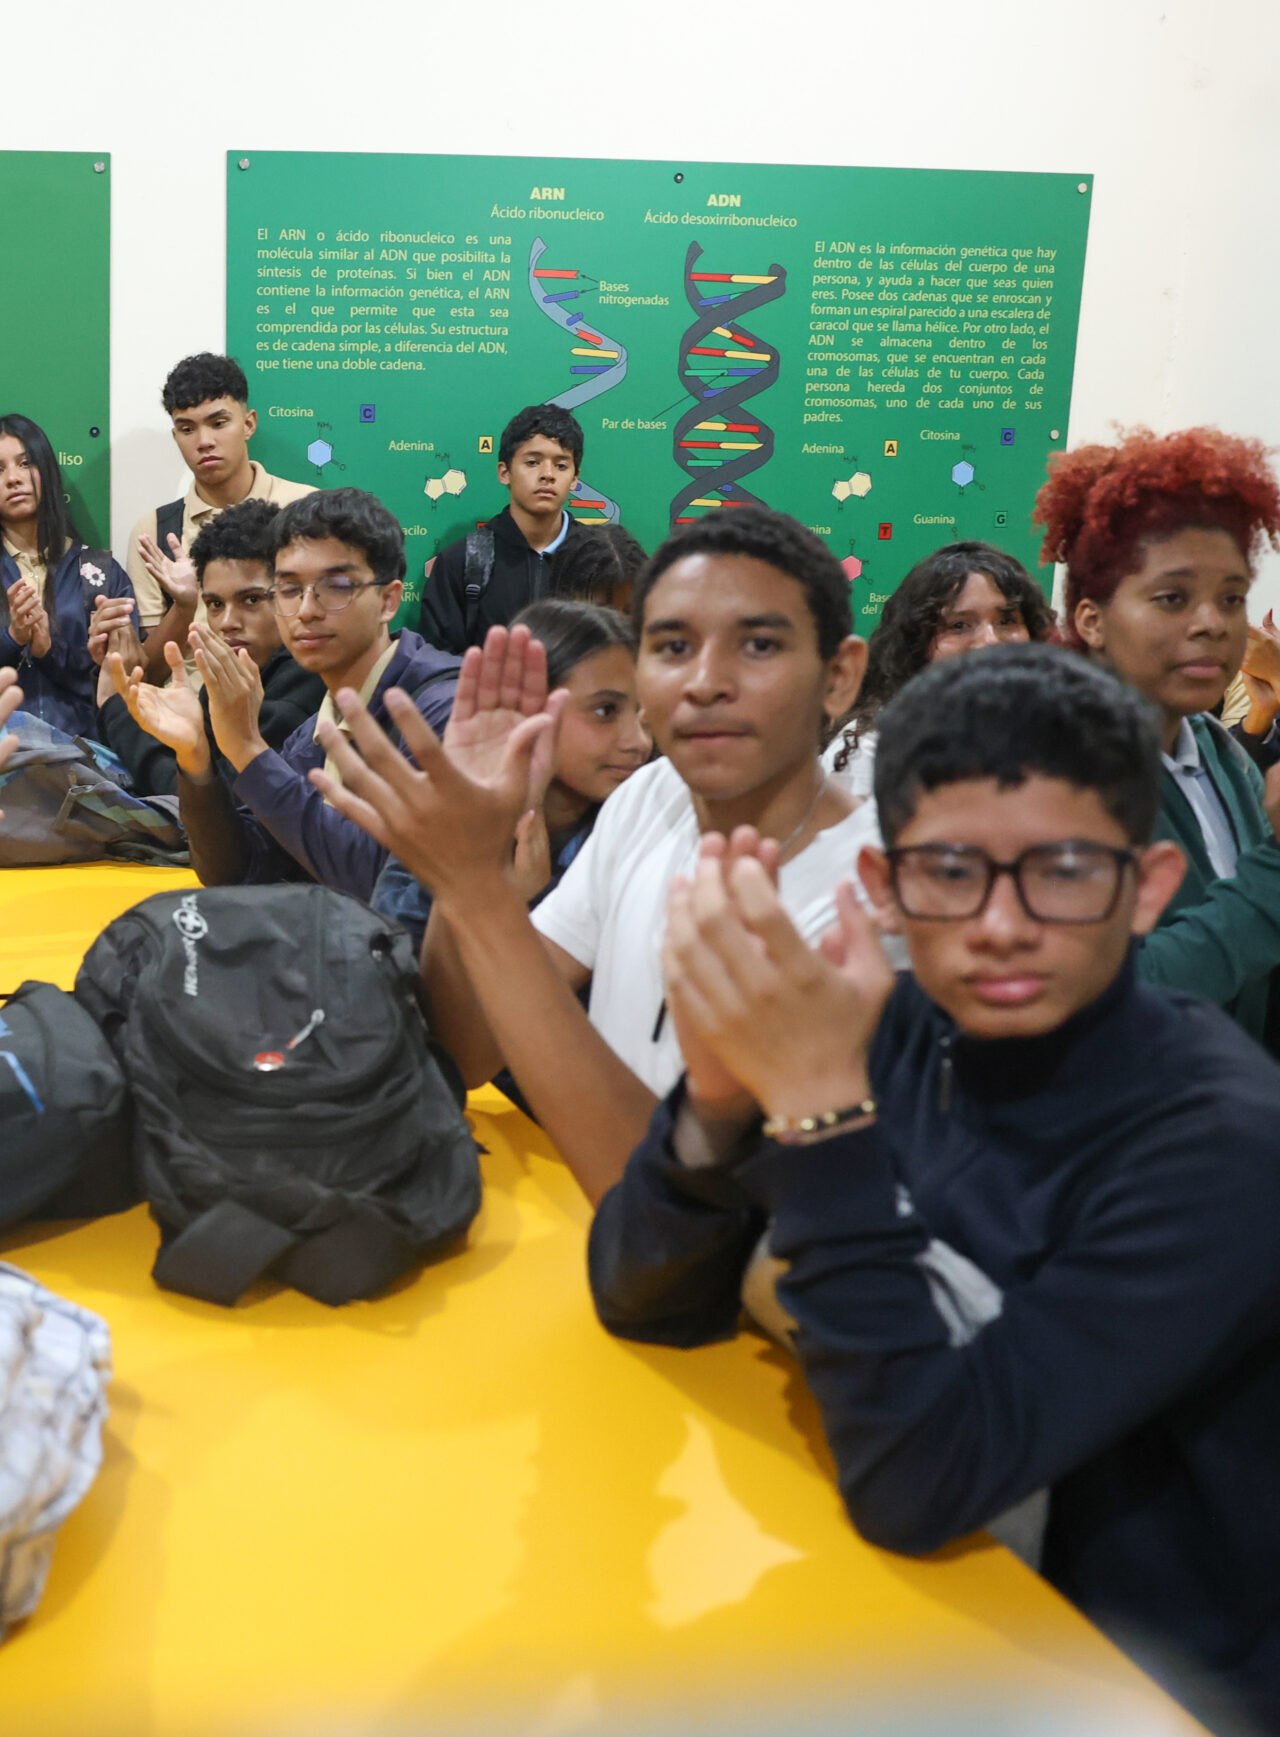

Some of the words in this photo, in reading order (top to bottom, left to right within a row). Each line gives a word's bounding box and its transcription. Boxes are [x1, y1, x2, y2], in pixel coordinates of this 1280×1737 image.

[529, 187, 564, 200] ARN
[706, 194, 741, 207] ADN
[490, 204, 526, 218] Ácido
[528, 206, 604, 220] ribonucleico
[643, 209, 678, 224] Ácido
[680, 212, 797, 226] desoxirribonucleico
[257, 227, 268, 240] El
[278, 228, 306, 240] ARN
[316, 231, 325, 241] o
[335, 229, 369, 242] ácido
[380, 230, 455, 244] ribonucleico
[465, 235, 478, 244] es
[488, 235, 512, 245] una
[257, 246, 313, 259] molécula
[318, 247, 359, 260] similar
[363, 248, 374, 260] al
[379, 248, 408, 261] ADN
[412, 252, 436, 264] que
[440, 250, 496, 265] posibilita
[500, 251, 511, 263] la
[814, 240, 825, 252] El
[828, 241, 855, 253] ADN
[859, 244, 872, 254] es
[875, 242, 885, 254] la
[889, 242, 956, 255] información
[959, 245, 1007, 260] genética
[1011, 248, 1033, 260] que
[1036, 246, 1056, 261] hay
[813, 256, 851, 269] dentro
[857, 257, 872, 269] de
[879, 258, 894, 270] las
[900, 258, 938, 271] células
[944, 259, 962, 271] del
[968, 263, 1007, 275] cuerpo
[1013, 261, 1028, 273] de
[1034, 264, 1055, 273] una
[256, 265, 302, 278] síntesis
[310, 265, 327, 278] de
[336, 266, 396, 281] proteínas.
[406, 267, 416, 280] Si
[426, 267, 453, 280] bien
[462, 268, 473, 280] el
[482, 269, 510, 281] ADN
[599, 280, 629, 292] Bases
[598, 293, 669, 308] nitrogenadas
[268, 406, 314, 417] Citosina
[363, 408, 372, 419] C
[602, 418, 619, 428] Par
[620, 418, 635, 429] de
[637, 418, 666, 429] bases
[919, 429, 960, 440] Citosina
[1004, 432, 1012, 442] C
[388, 439, 434, 450] Adenina
[481, 440, 490, 450] A
[801, 442, 844, 454] Adenina
[886, 443, 895, 453] A
[58, 451, 82, 465] liso
[913, 513, 955, 524] Guanina
[997, 515, 1005, 524] G
[402, 525, 427, 536] acilo
[881, 526, 890, 536] T
